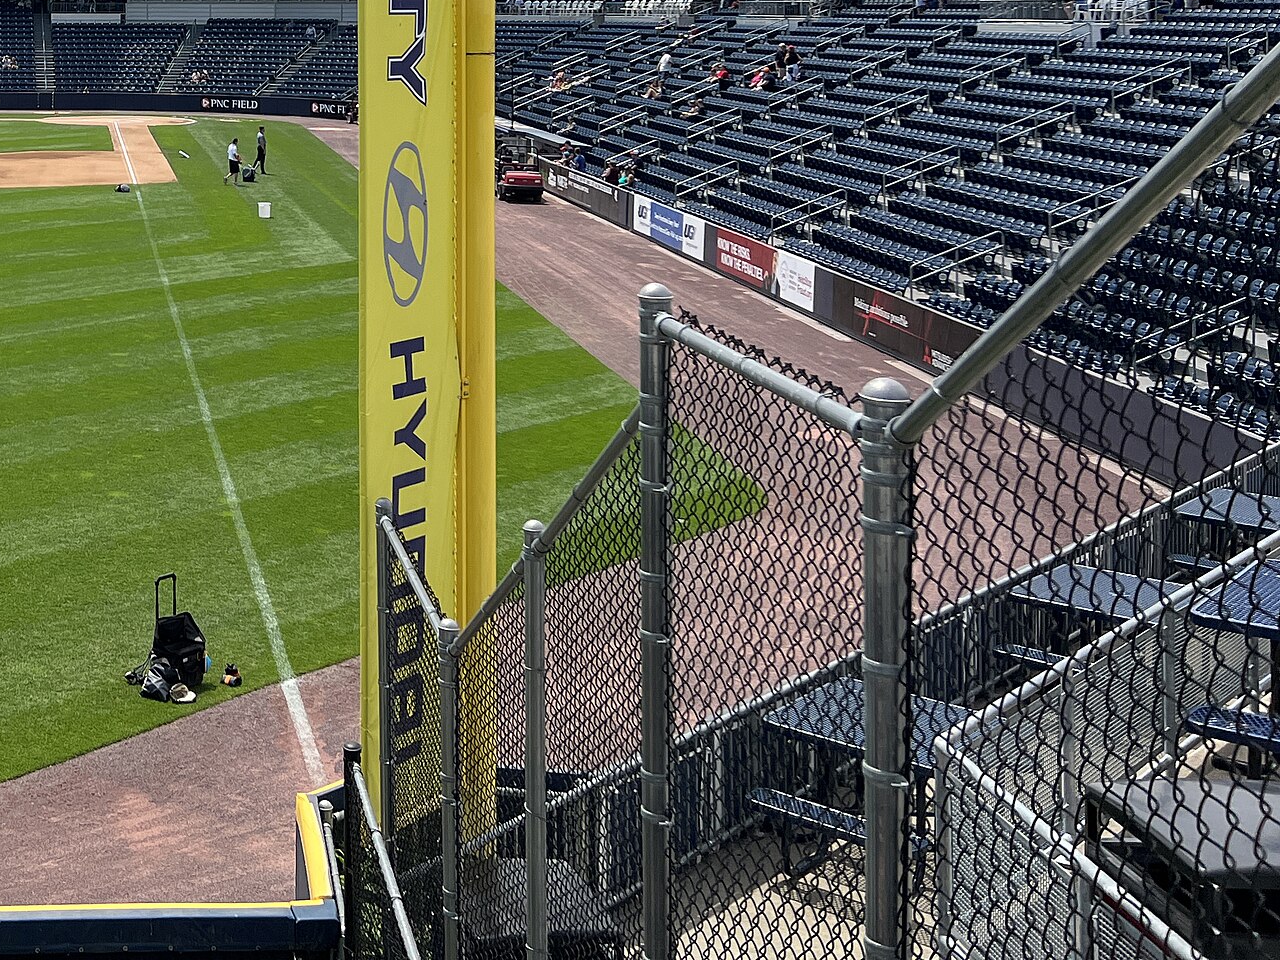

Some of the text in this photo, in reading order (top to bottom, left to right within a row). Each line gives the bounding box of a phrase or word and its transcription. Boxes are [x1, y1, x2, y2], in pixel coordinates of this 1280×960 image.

[210, 98, 259, 109] PNC FIELD
[319, 103, 336, 113] PNC
